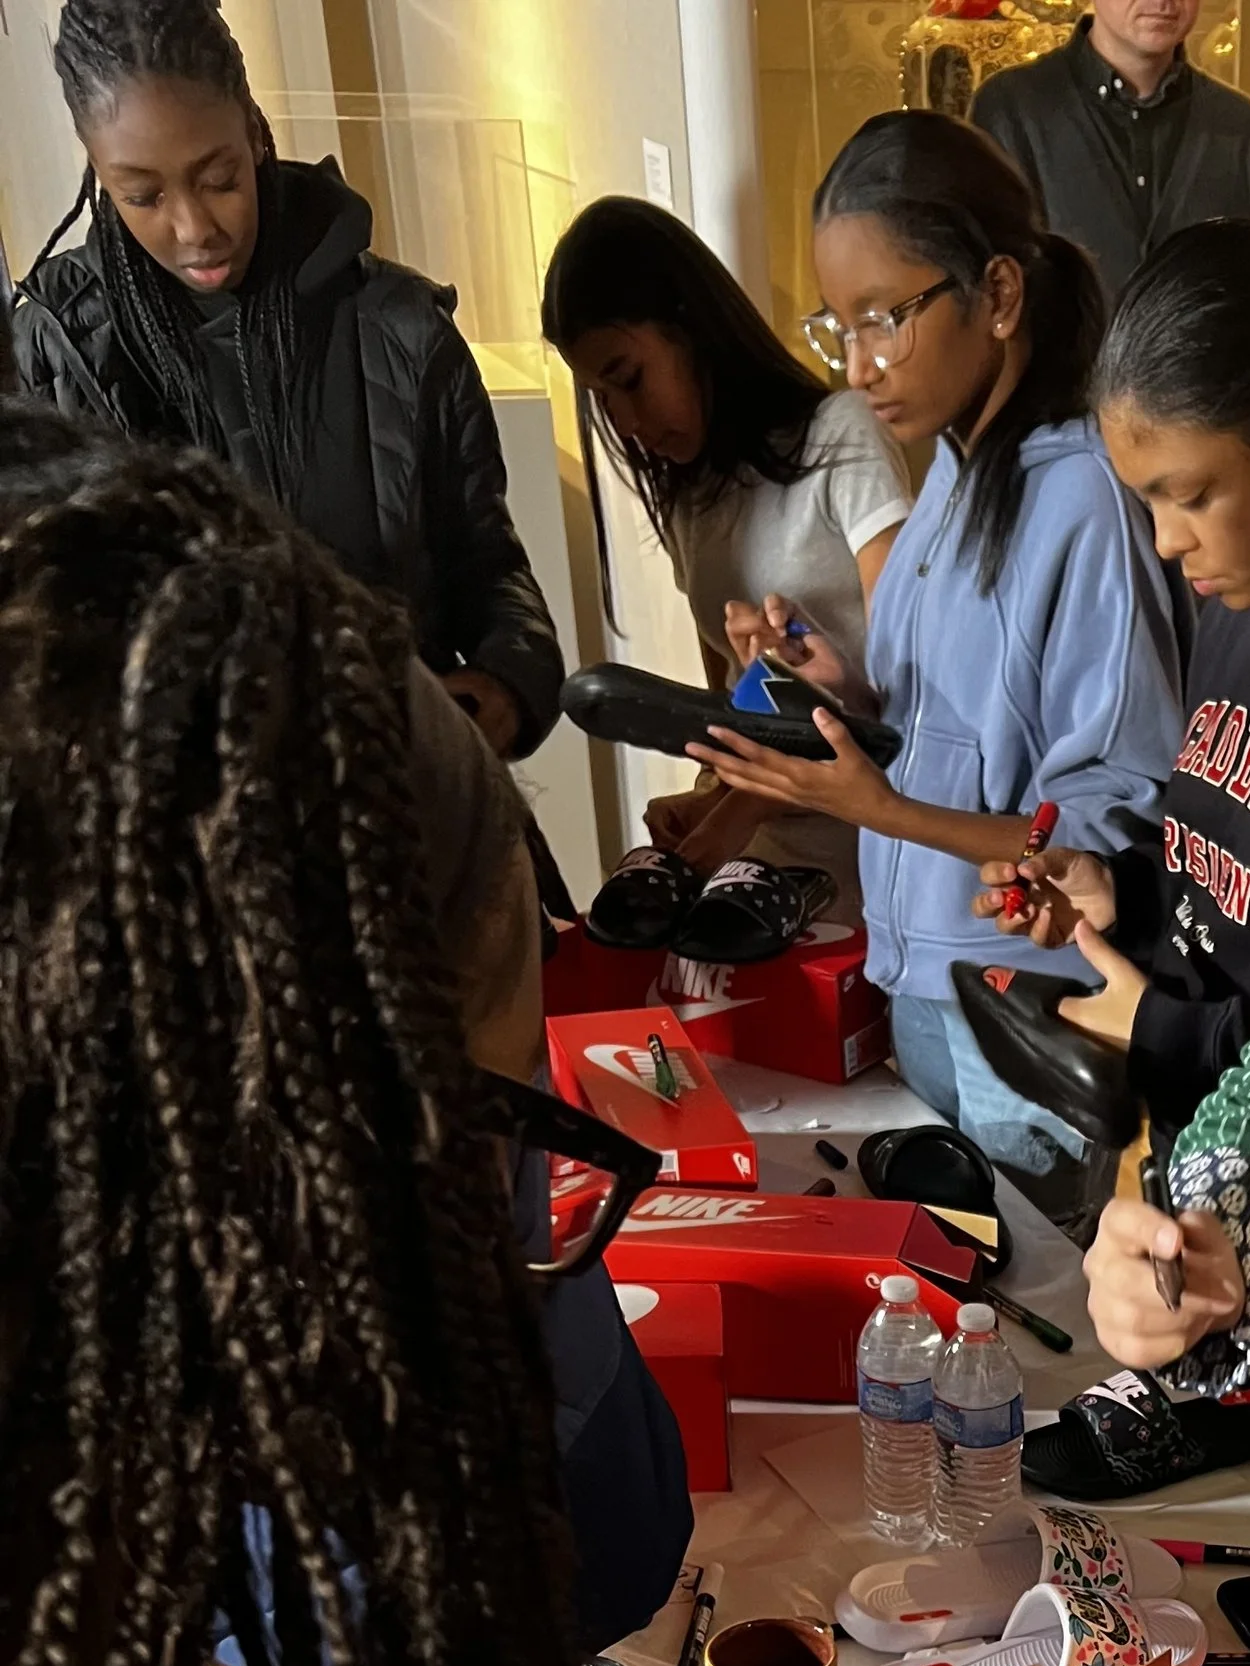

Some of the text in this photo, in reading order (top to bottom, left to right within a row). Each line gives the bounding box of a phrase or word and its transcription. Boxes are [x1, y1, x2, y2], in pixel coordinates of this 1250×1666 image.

[714, 861, 765, 882] NIKE
[660, 954, 736, 1001] NIKE
[632, 1194, 766, 1219] NIKE
